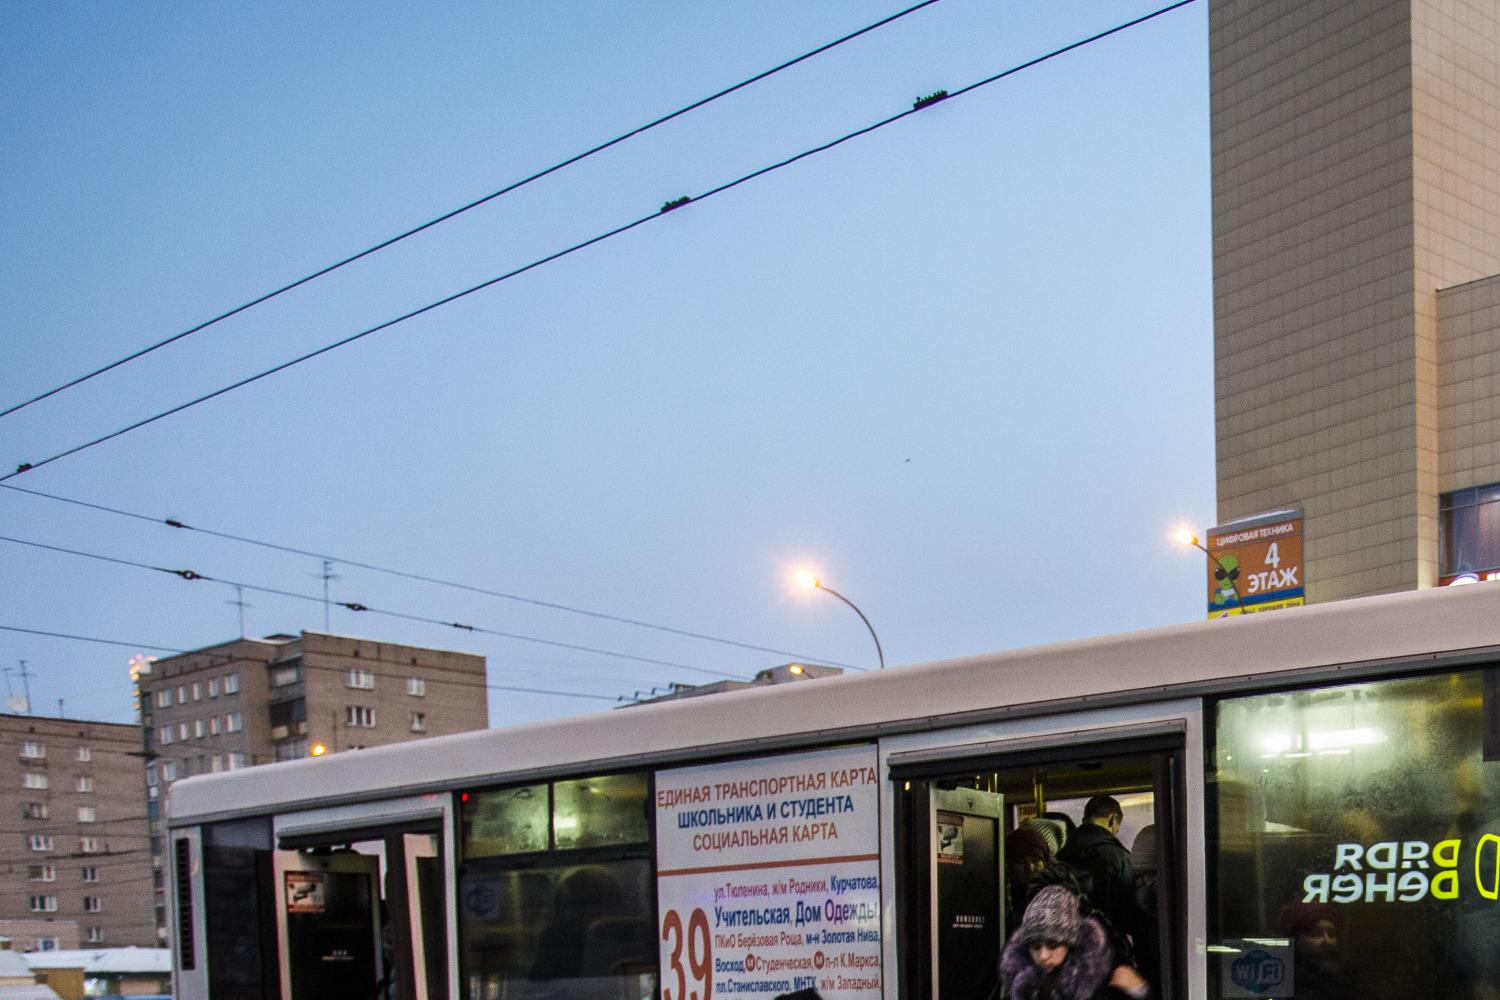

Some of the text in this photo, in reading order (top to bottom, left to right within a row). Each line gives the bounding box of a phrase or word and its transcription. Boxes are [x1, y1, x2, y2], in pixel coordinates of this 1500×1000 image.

[1217, 523, 1294, 546] ЦИФРОВАЯ ТЕХНИКА
[1265, 542, 1280, 569] 4
[1247, 566, 1298, 593] ЭТАЖ
[657, 767, 877, 809] ЕДИНАЯ ТРАНСПОРТНАЯ КАРТА
[678, 795, 854, 829] ШКОЛЬНИКА И СТУДЕНТА
[693, 822, 838, 852] СОЦИАЛЬНАЯ КАРТА
[789, 878, 828, 898] Родники,
[830, 876, 880, 893] Курчатова,
[714, 905, 792, 927] Учительская,
[795, 901, 822, 927] Дом
[714, 927, 880, 949] ПКиО Берёзовая Роща, м-н Золотая Нива,
[715, 957, 746, 974] Восход,
[755, 955, 814, 975] Студенческая,
